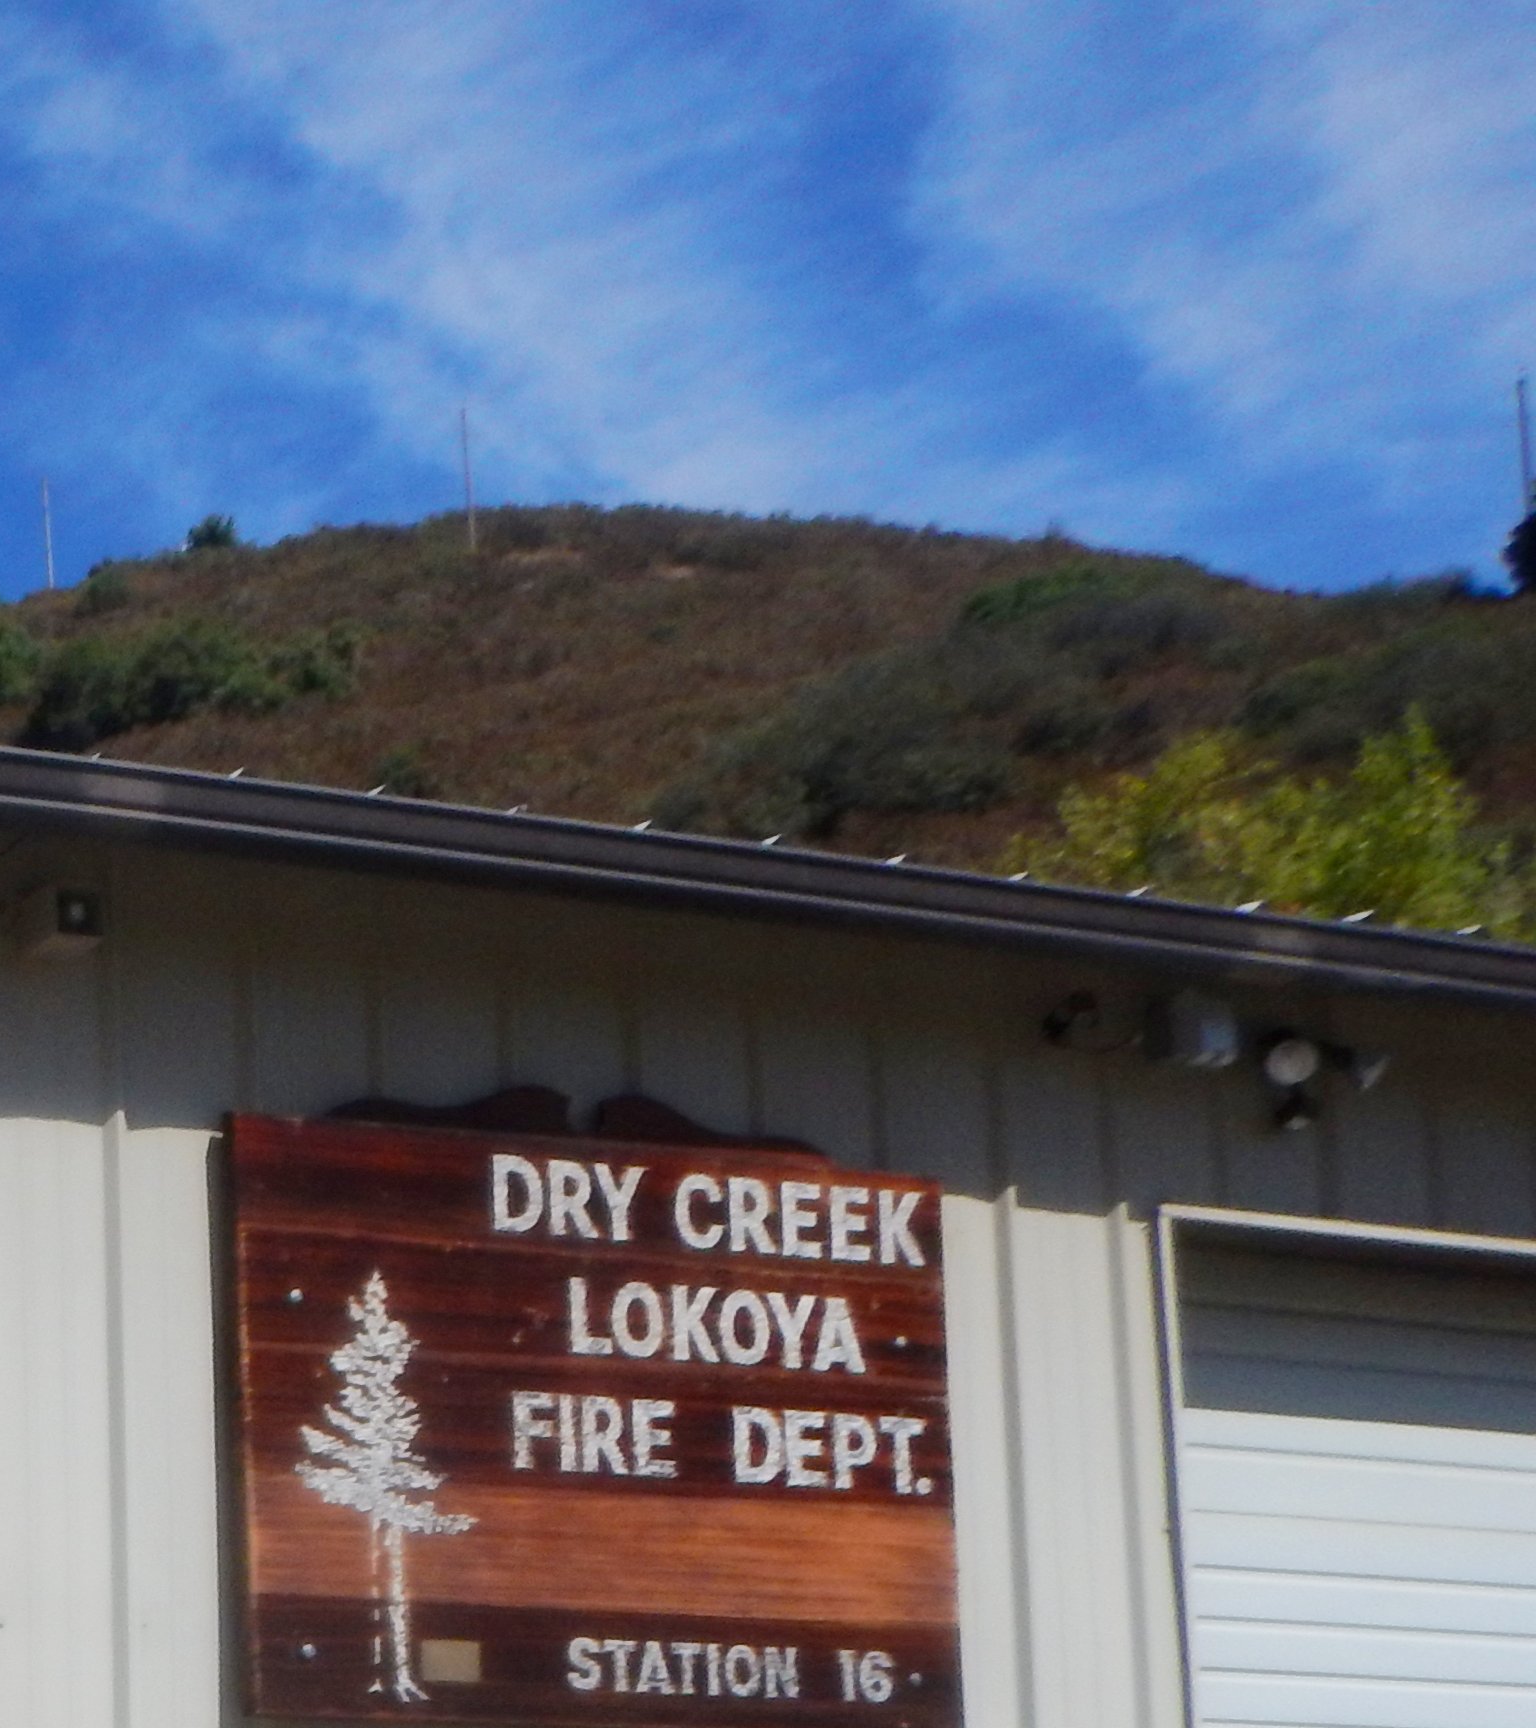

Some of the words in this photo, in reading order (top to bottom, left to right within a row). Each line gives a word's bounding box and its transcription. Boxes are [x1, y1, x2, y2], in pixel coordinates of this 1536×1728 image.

[491, 1153, 648, 1242] DRY
[675, 1174, 926, 1268] CREEK
[568, 1276, 866, 1374] LOKOYA
[511, 1391, 678, 1479] FIRE
[731, 1406, 933, 1497] DEPT.
[566, 1638, 800, 1700] STATION
[839, 1652, 895, 1703] 16
